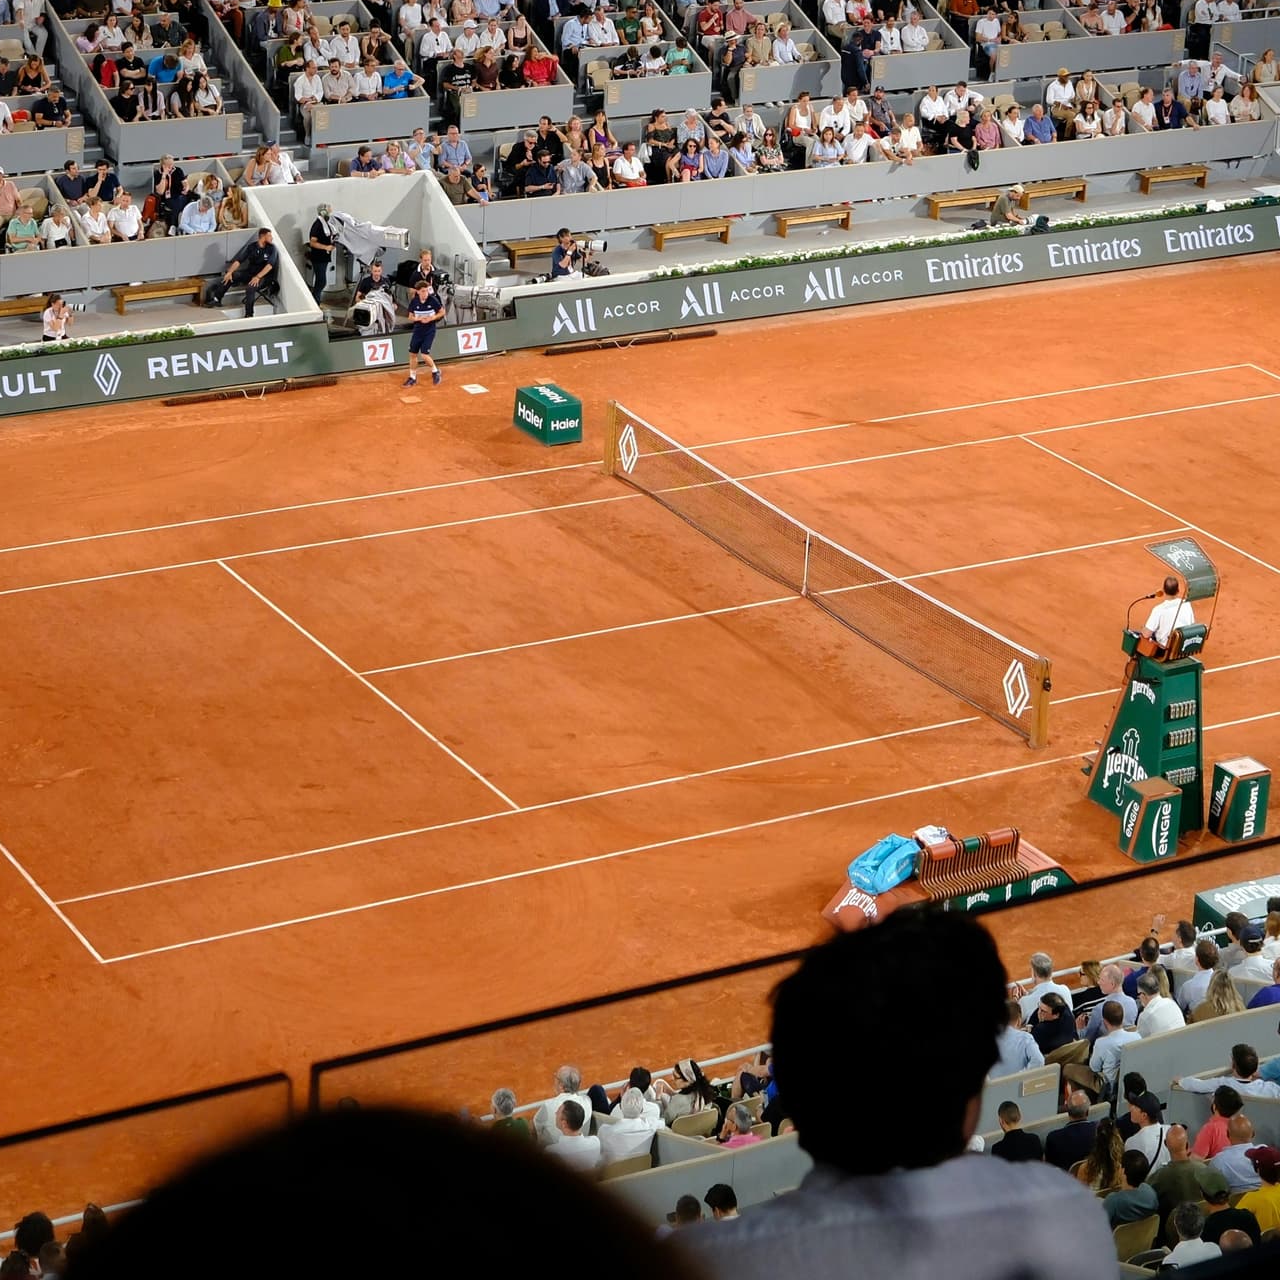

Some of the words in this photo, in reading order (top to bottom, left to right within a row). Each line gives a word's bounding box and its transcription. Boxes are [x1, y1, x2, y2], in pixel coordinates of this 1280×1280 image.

[1046, 235, 1142, 269] Emirates
[1163, 221, 1255, 254] Emirates
[850, 268, 904, 287] ACCOR
[926, 248, 1024, 284] Emirates
[729, 284, 785, 303] ACCOR
[602, 299, 661, 320] ACCOR
[367, 343, 389, 362] 27
[462, 331, 483, 350] 27
[147, 341, 293, 381] RENAULT
[518, 401, 544, 430] Haier
[550, 418, 580, 431] Haier
[1210, 775, 1232, 818] Wilson
[1242, 785, 1260, 839] Wilson
